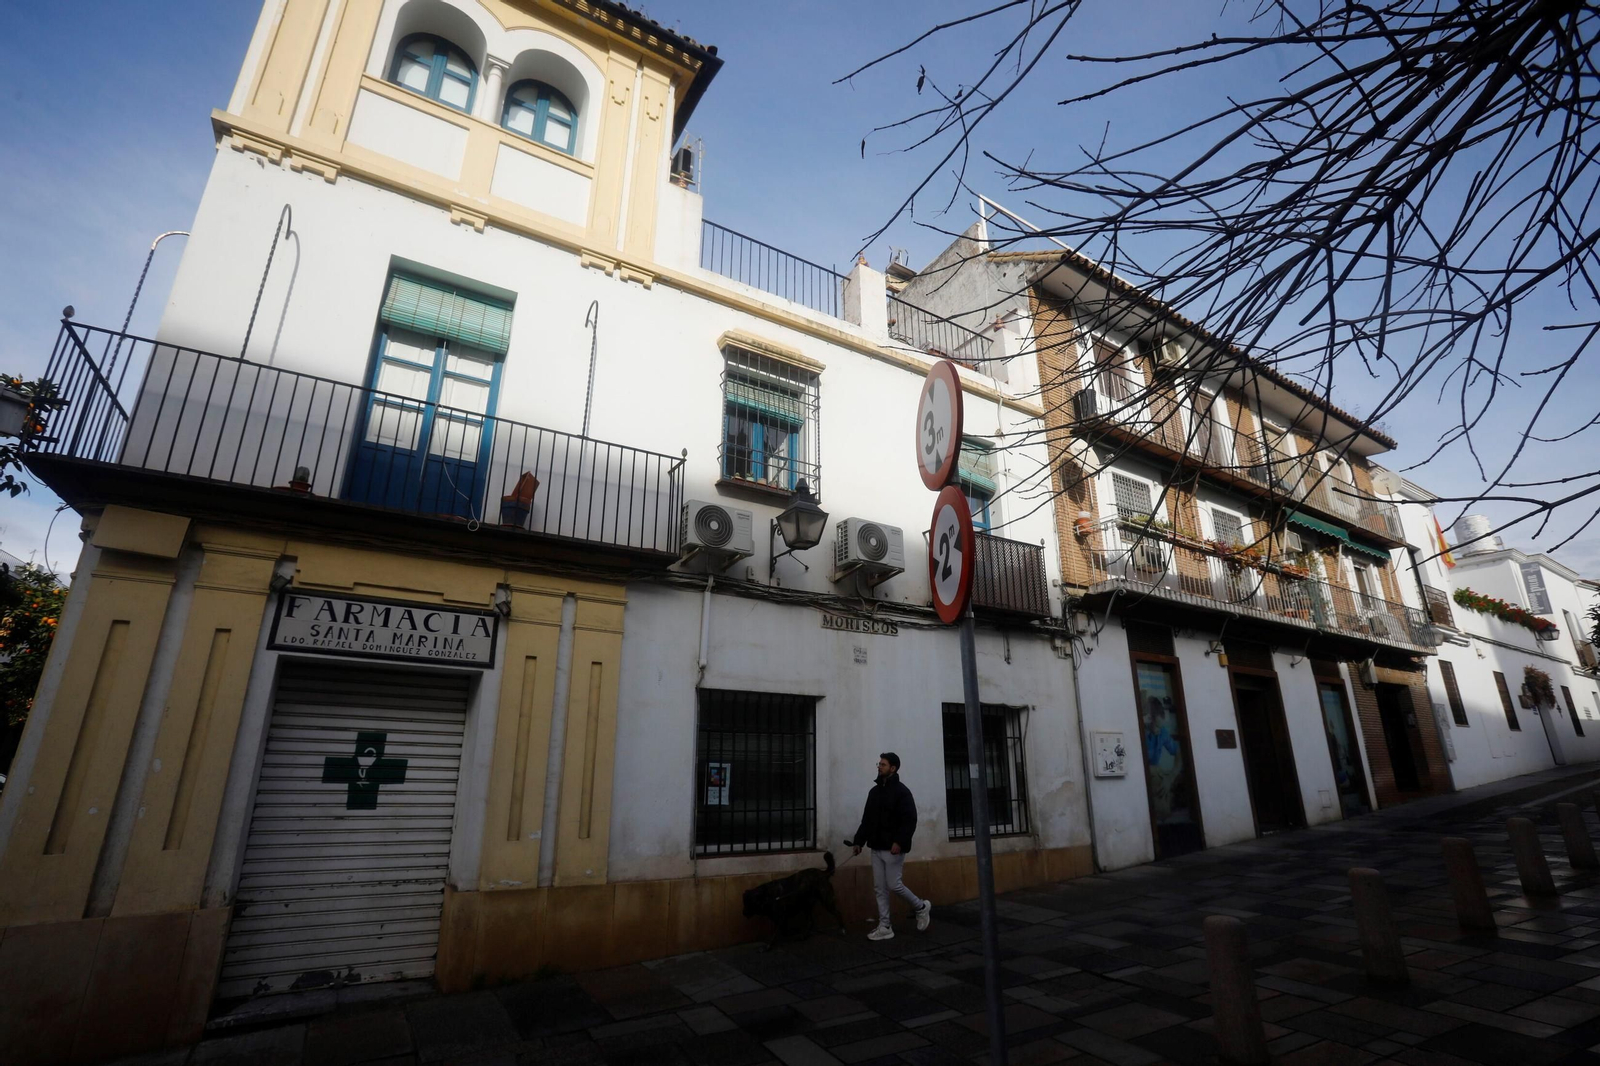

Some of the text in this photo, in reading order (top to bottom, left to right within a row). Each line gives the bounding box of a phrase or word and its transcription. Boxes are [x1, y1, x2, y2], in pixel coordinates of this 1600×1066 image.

[284, 596, 491, 638] FARMACIA
[822, 615, 899, 635] MORISCOS
[283, 636, 477, 660] LDO. RAFAEL DOMINGUEZ GONZALEZ
[310, 624, 465, 651] SANTA MARINA
